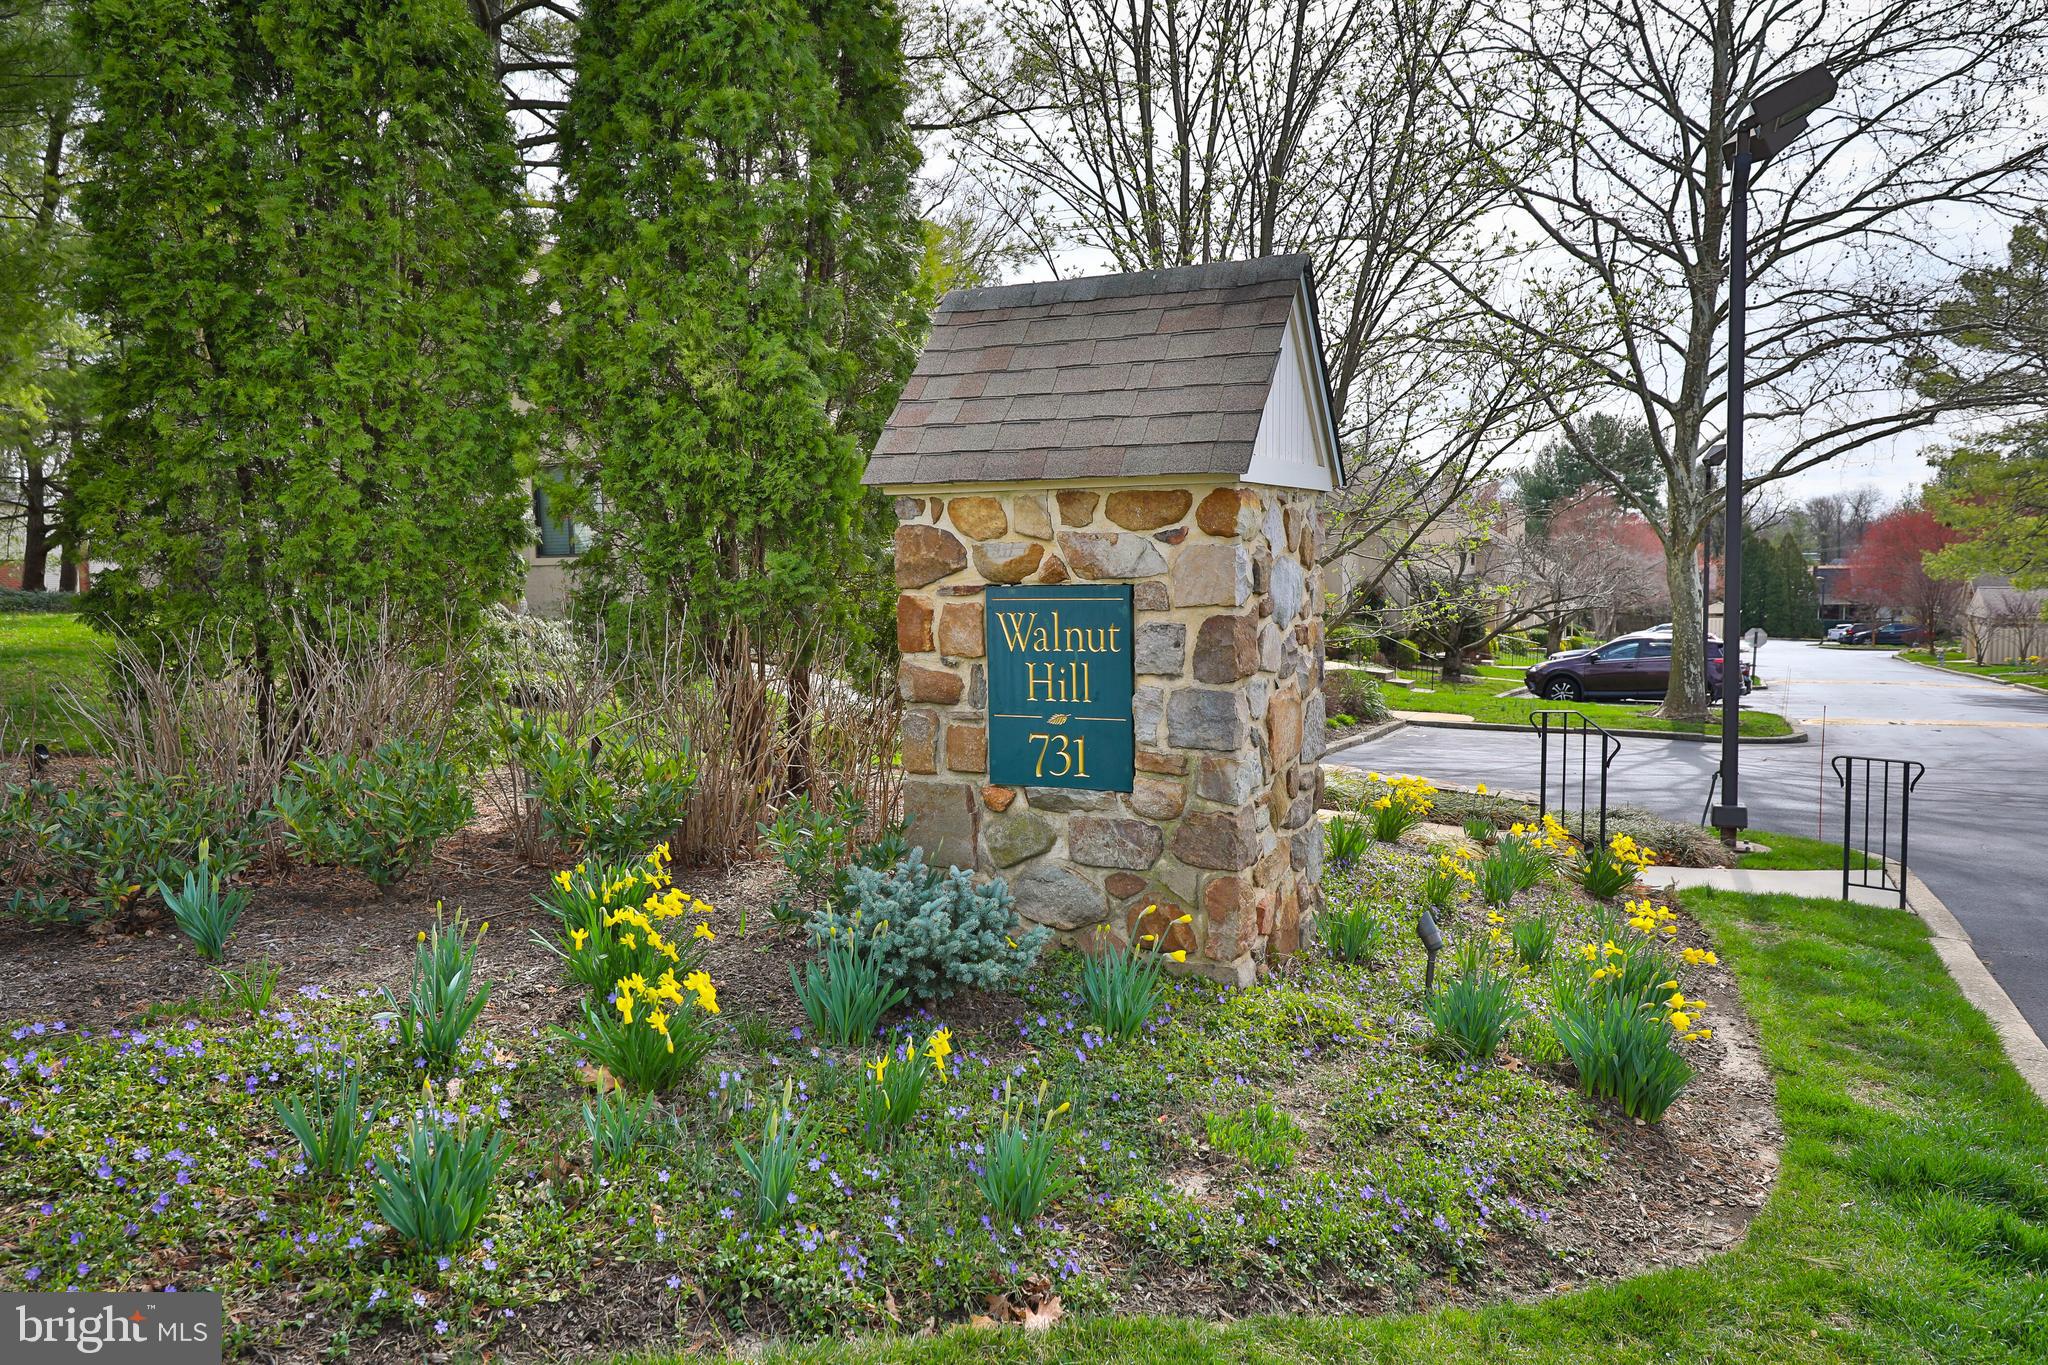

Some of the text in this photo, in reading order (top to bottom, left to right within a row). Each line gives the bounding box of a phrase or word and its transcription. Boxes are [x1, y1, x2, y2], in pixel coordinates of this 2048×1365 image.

[995, 608, 1122, 653] Walnut
[1025, 660, 1093, 703] Hill
[1028, 732, 1091, 778] 731
